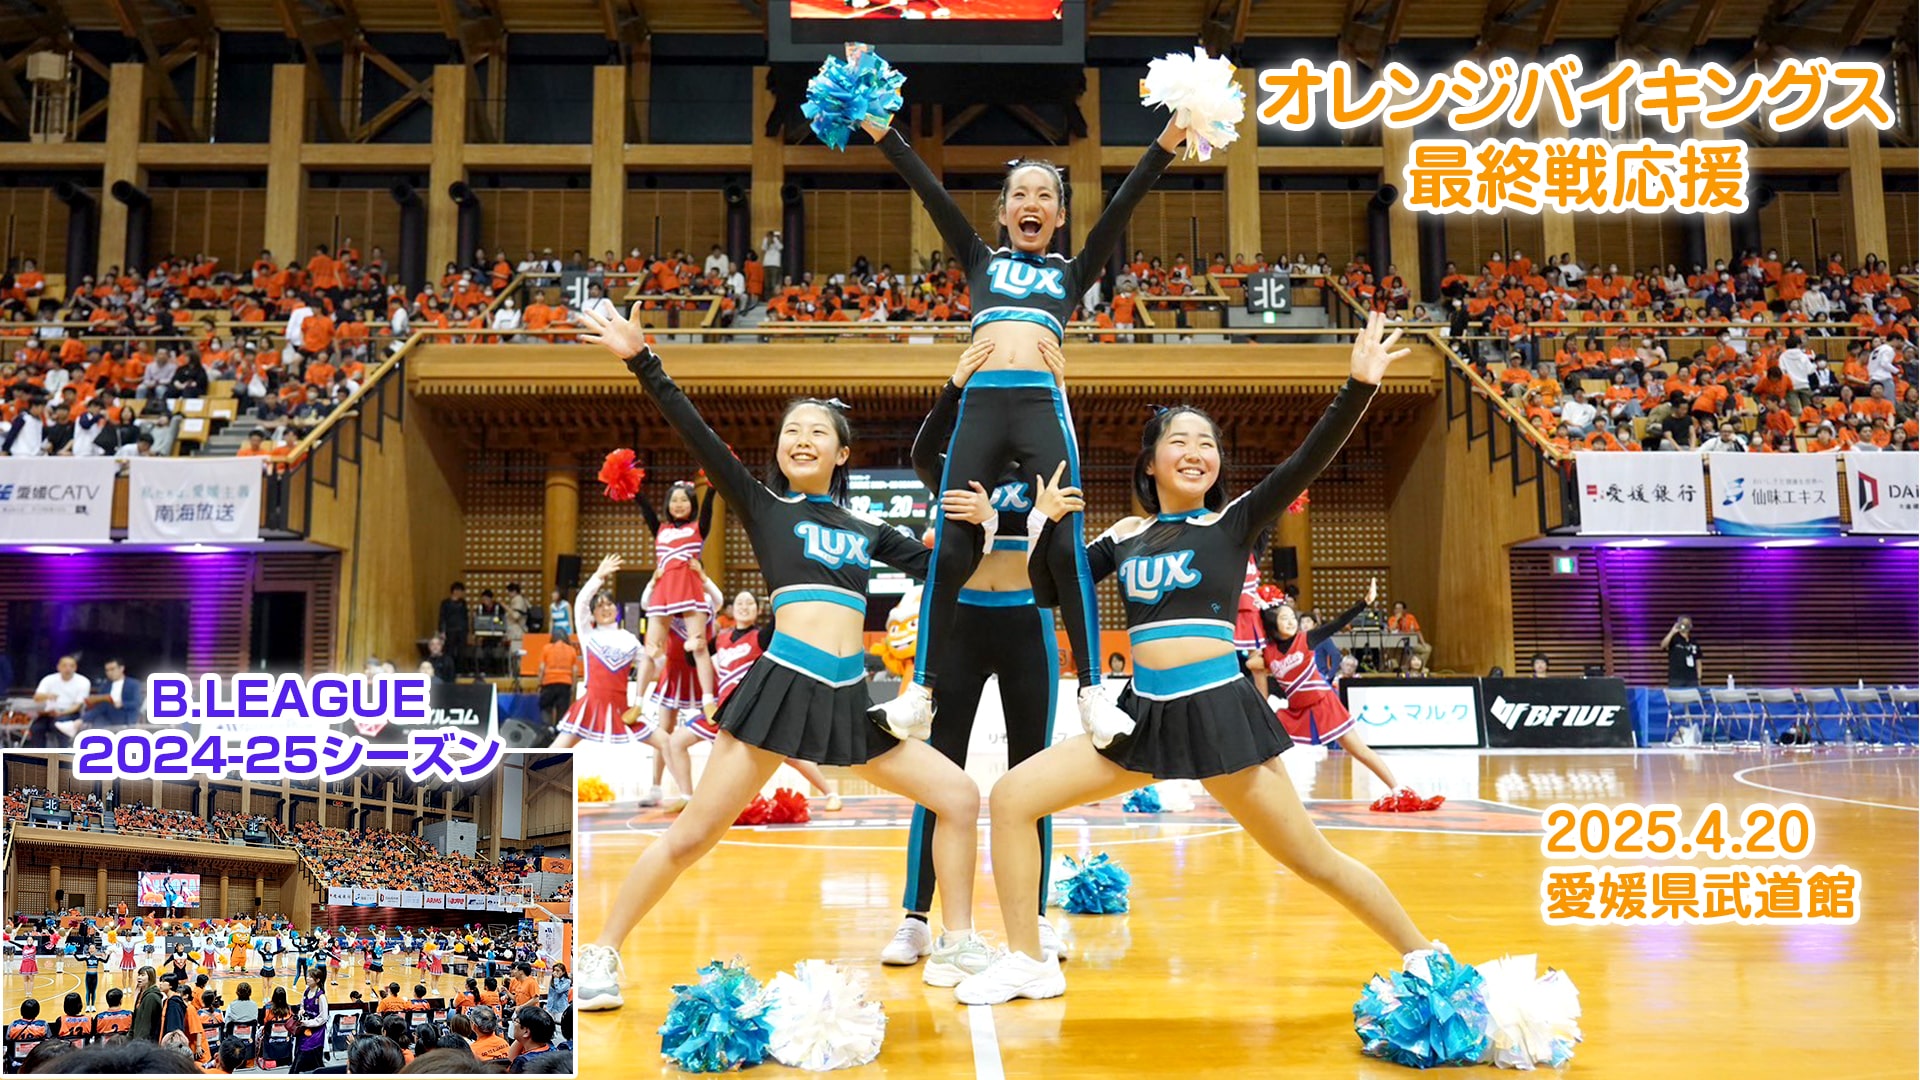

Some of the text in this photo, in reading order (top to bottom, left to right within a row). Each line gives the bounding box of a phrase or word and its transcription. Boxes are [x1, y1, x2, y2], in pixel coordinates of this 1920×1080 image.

[988, 258, 1064, 296] LUX
[1253, 278, 1286, 309] 北
[1606, 483, 1697, 504] 愛媛銀行
[1752, 488, 1827, 506] 仙味エキス
[154, 502, 236, 522] 南海放送
[796, 523, 870, 566] LUX
[1119, 551, 1198, 601] LUX
[1403, 704, 1468, 720] マルク
